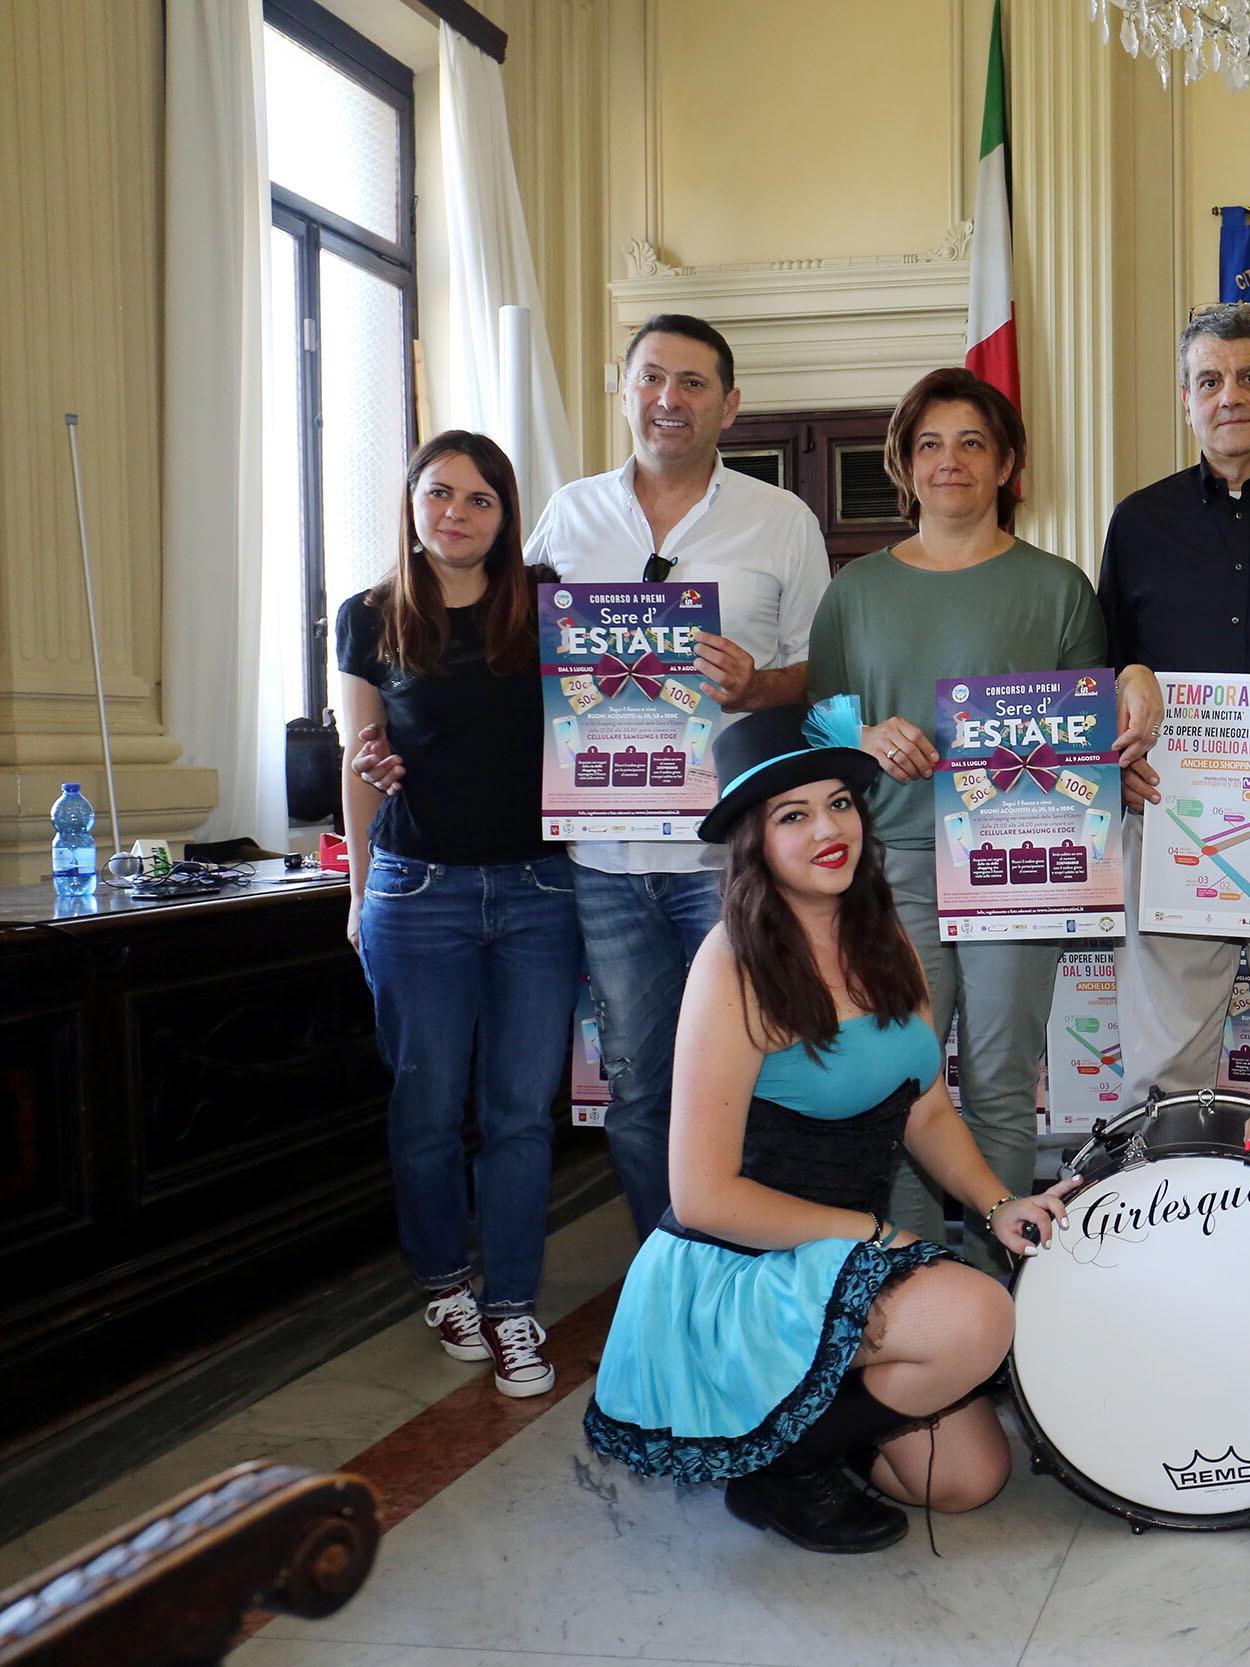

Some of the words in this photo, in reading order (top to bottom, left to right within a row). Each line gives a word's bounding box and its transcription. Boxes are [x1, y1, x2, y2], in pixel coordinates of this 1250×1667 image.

[590, 594, 631, 604] CONCORSO
[634, 595, 639, 603] A
[641, 594, 666, 603] PREMI
[601, 608, 638, 625] Sere
[643, 608, 657, 624] d'
[569, 626, 692, 655] ESTATE
[986, 685, 1026, 696] CONCORSO
[1028, 685, 1034, 694] A
[1036, 683, 1061, 694] PREMI
[996, 700, 1032, 716] Sere
[1037, 698, 1052, 715] d'
[1166, 709, 1173, 719] IL
[1174, 708, 1199, 719] MOCA
[1201, 711, 1210, 720] VA
[1212, 711, 1221, 720] IN
[964, 716, 1086, 748] ESTATE
[1163, 725, 1174, 736] 26
[1176, 726, 1203, 737] OPERE
[1205, 727, 1218, 738] NEI
[1220, 727, 1249, 739] NEGOZI
[1168, 739, 1189, 752] DAL
[1193, 740, 1199, 753] 9
[1202, 739, 1240, 754] LUGLIO
[1183, 759, 1208, 769] ANCHE
[1210, 760, 1220, 769] LO
[1213, 807, 1224, 815] 06
[1168, 847, 1179, 855] 04
[1198, 876, 1209, 884] 03
[1069, 954, 1093, 964] OPERE
[1095, 954, 1107, 963] NEI
[1063, 966, 1082, 977] DAL
[1086, 966, 1091, 977] 9
[1094, 966, 1116, 977] LUG
